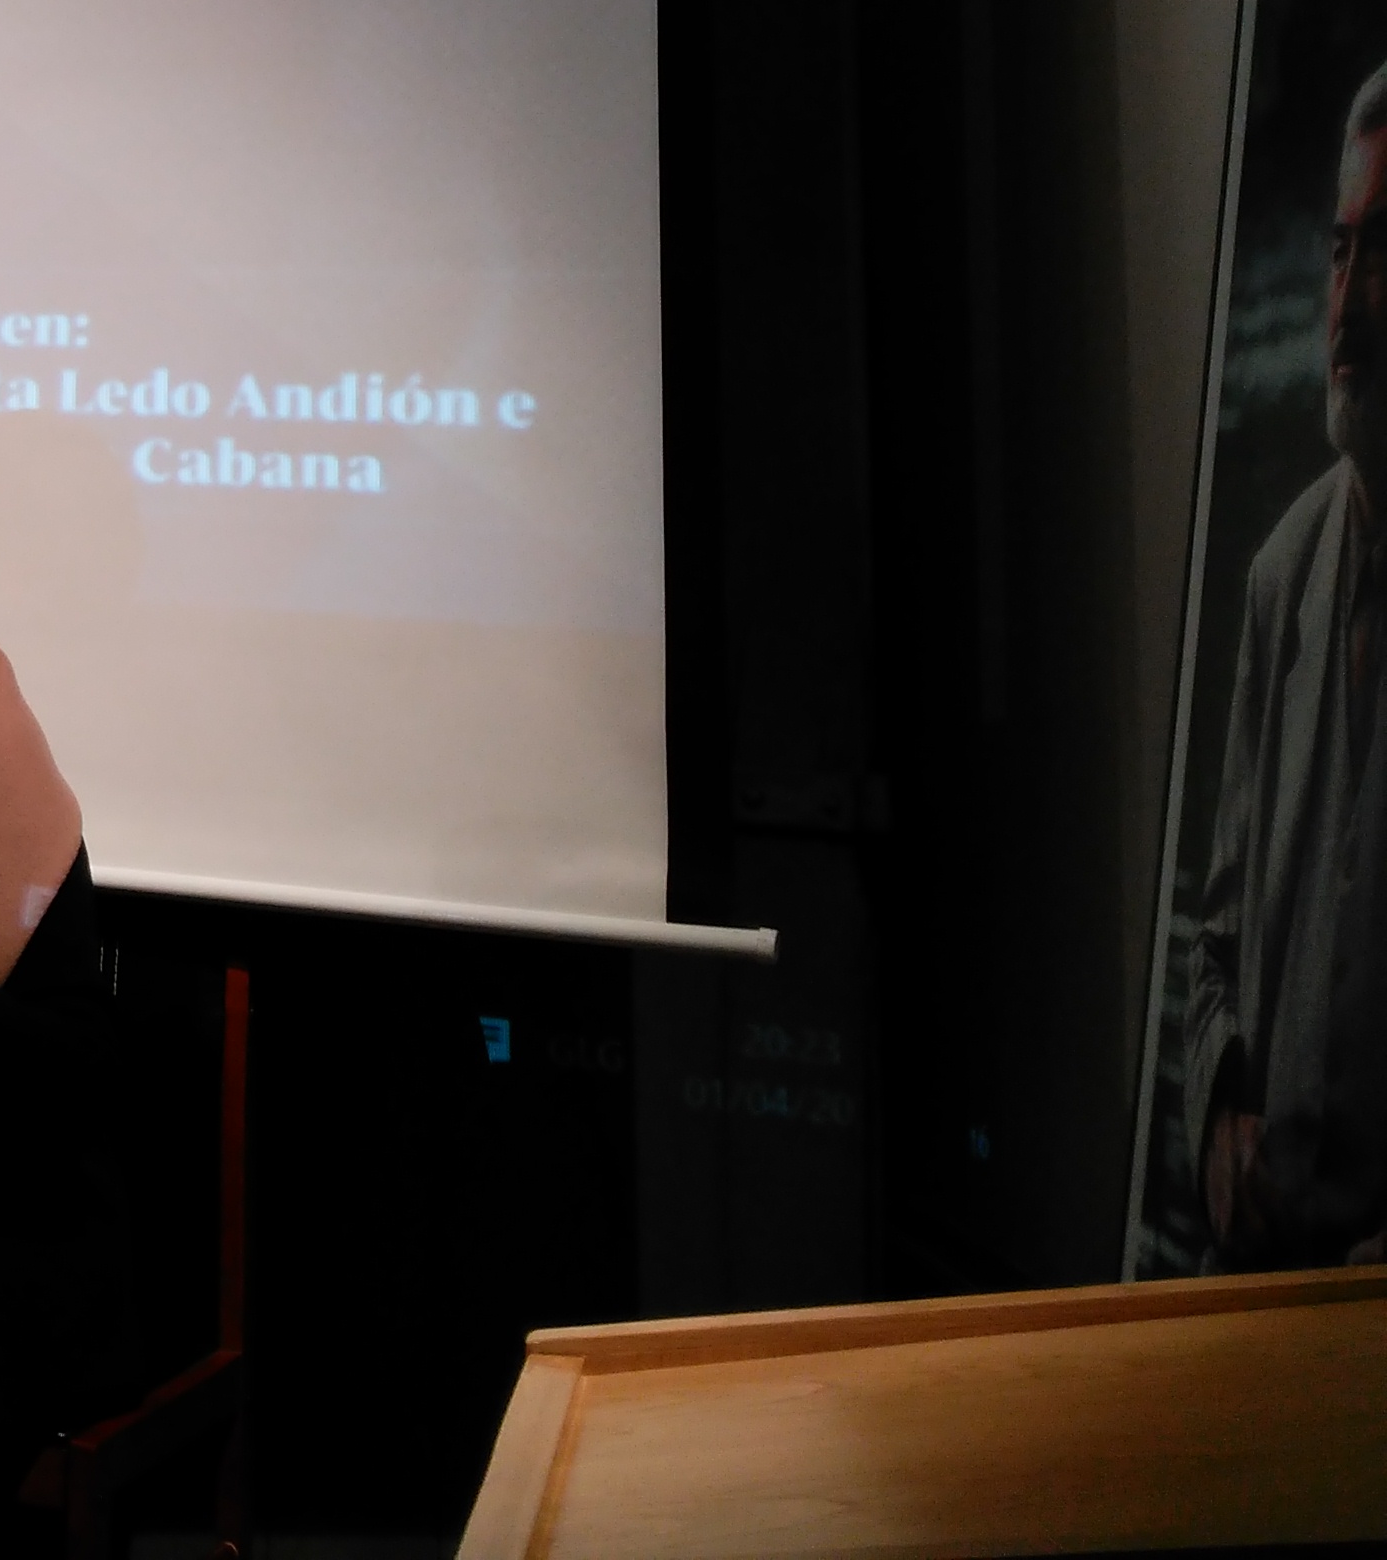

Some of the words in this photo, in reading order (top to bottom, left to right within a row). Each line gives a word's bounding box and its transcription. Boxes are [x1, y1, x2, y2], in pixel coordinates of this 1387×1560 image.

[59, 366, 211, 419] Ledo
[228, 370, 481, 426] Andión
[496, 390, 536, 430] e
[132, 435, 385, 494] Cabana
